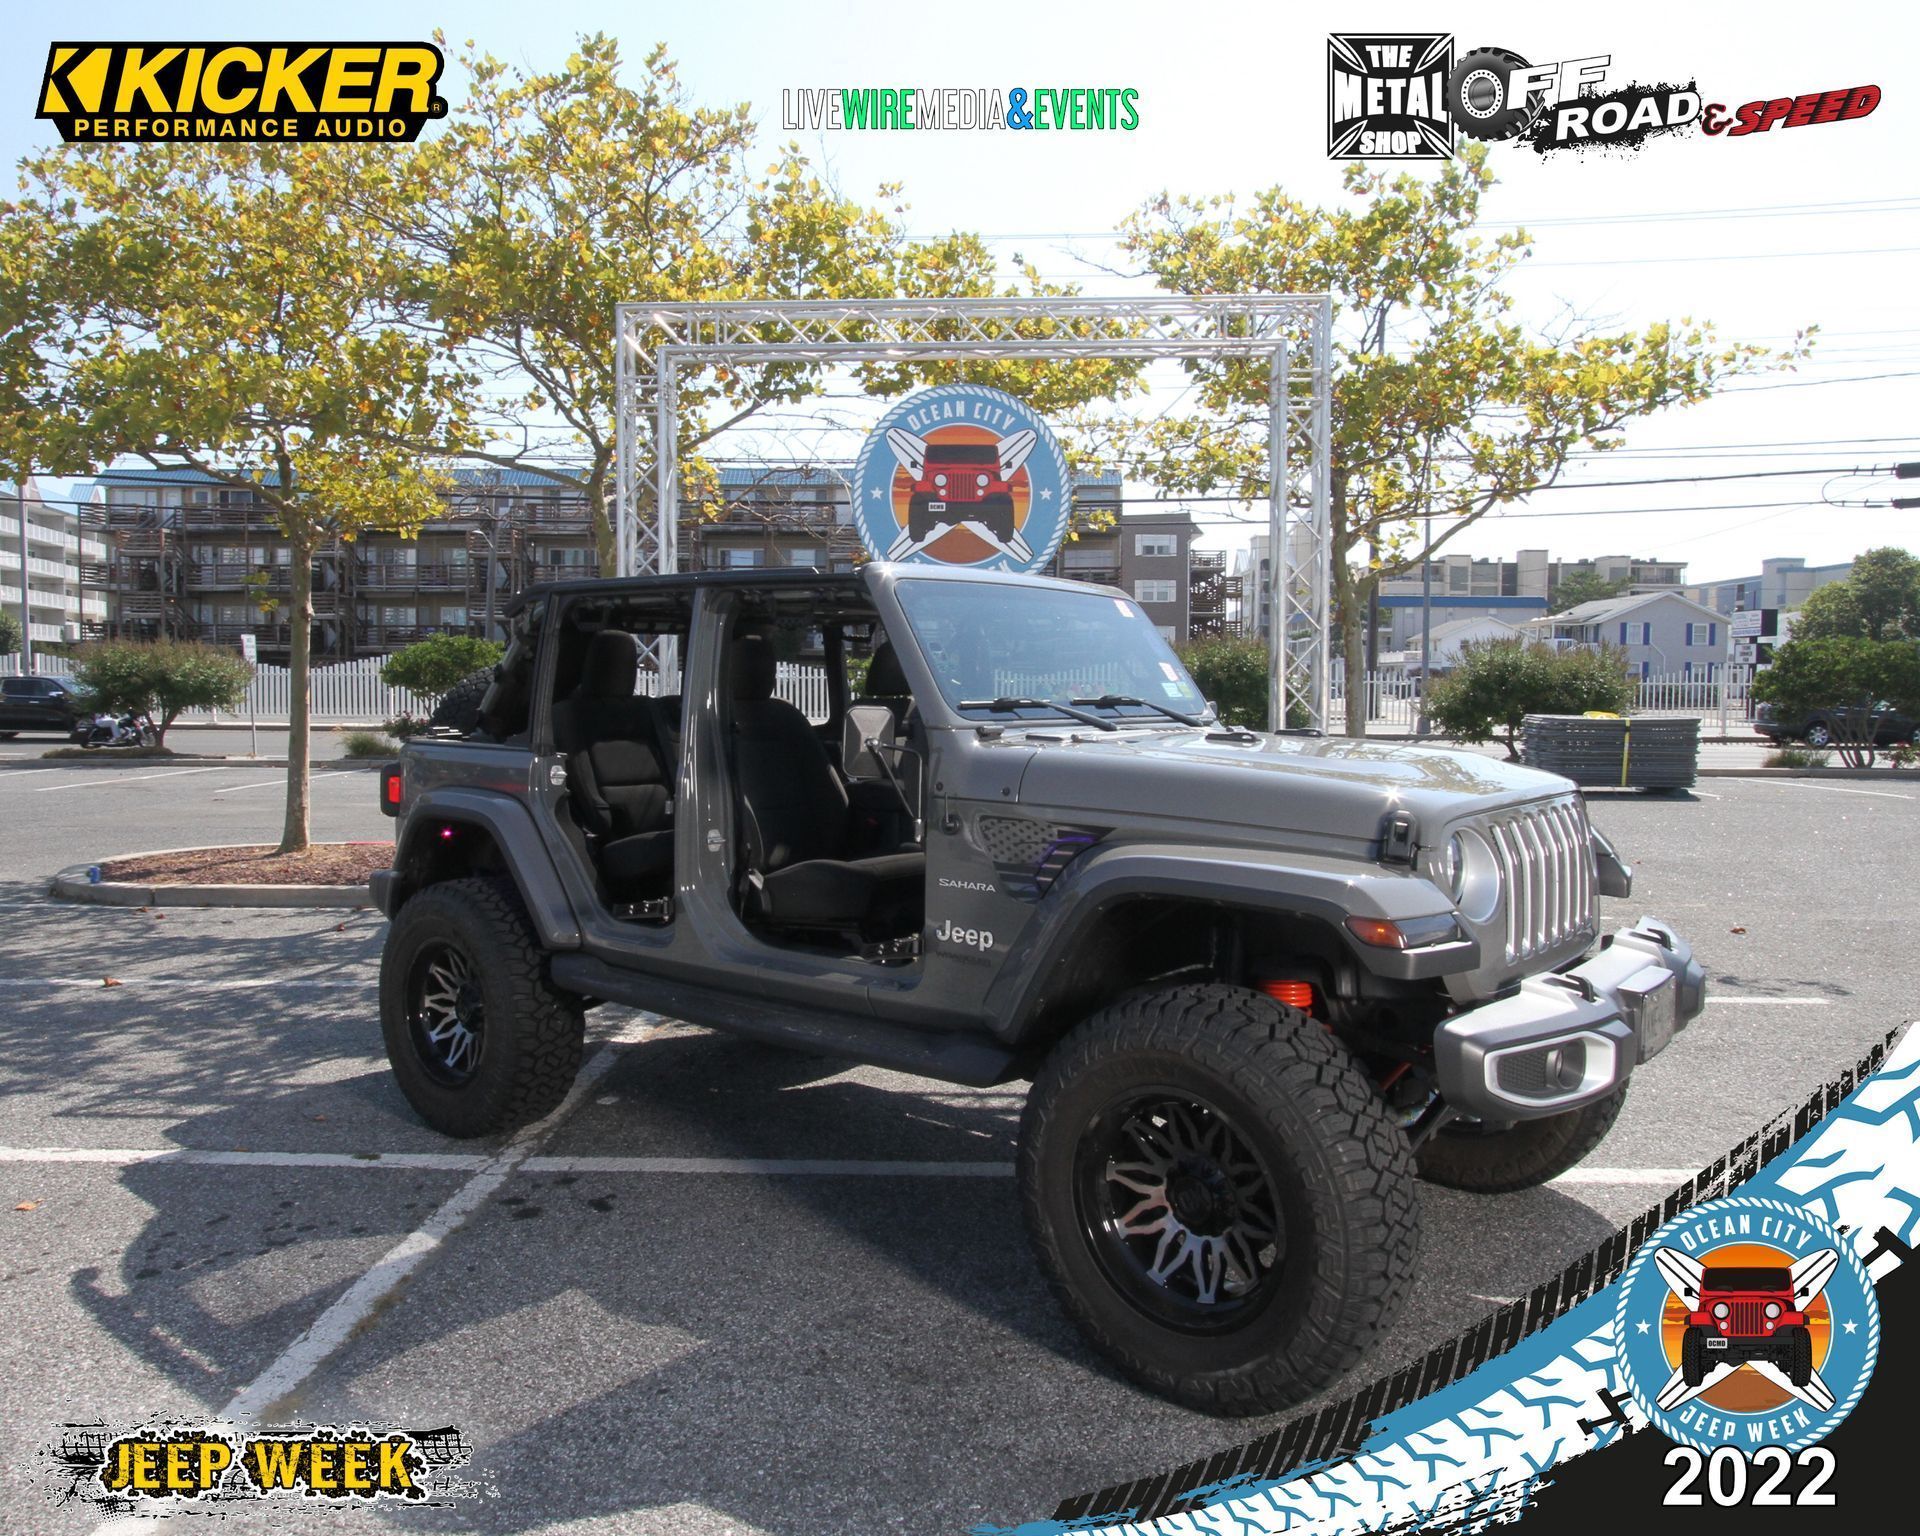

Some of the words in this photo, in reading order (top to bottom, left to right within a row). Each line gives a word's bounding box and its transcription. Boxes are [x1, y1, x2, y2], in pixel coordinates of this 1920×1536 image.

[906, 400, 965, 431] OCEAN
[973, 402, 1016, 430] CITY
[938, 878, 996, 893] SAHARA
[936, 919, 994, 952] Jeep
